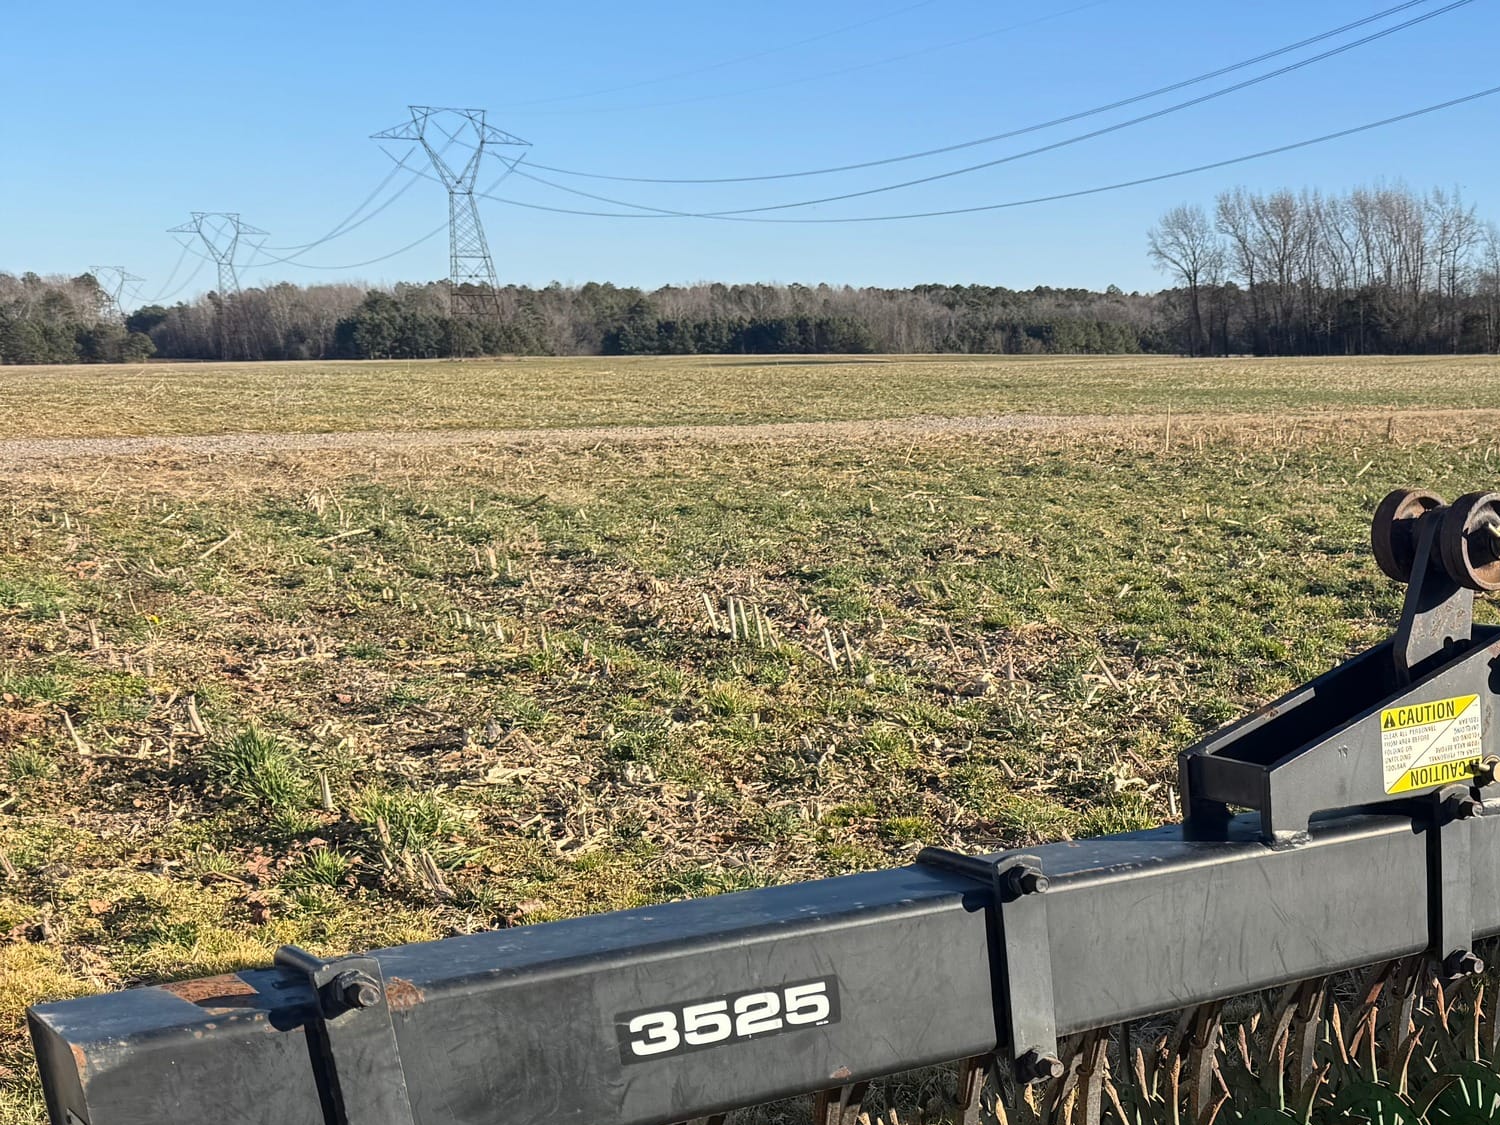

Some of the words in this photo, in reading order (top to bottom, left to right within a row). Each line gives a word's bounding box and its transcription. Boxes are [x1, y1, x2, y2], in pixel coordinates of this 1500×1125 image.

[1398, 700, 1455, 726] CAUTION
[1410, 725, 1436, 735] PERSONNEL
[1411, 761, 1465, 787] CAUTION
[629, 981, 831, 1056] 3525
